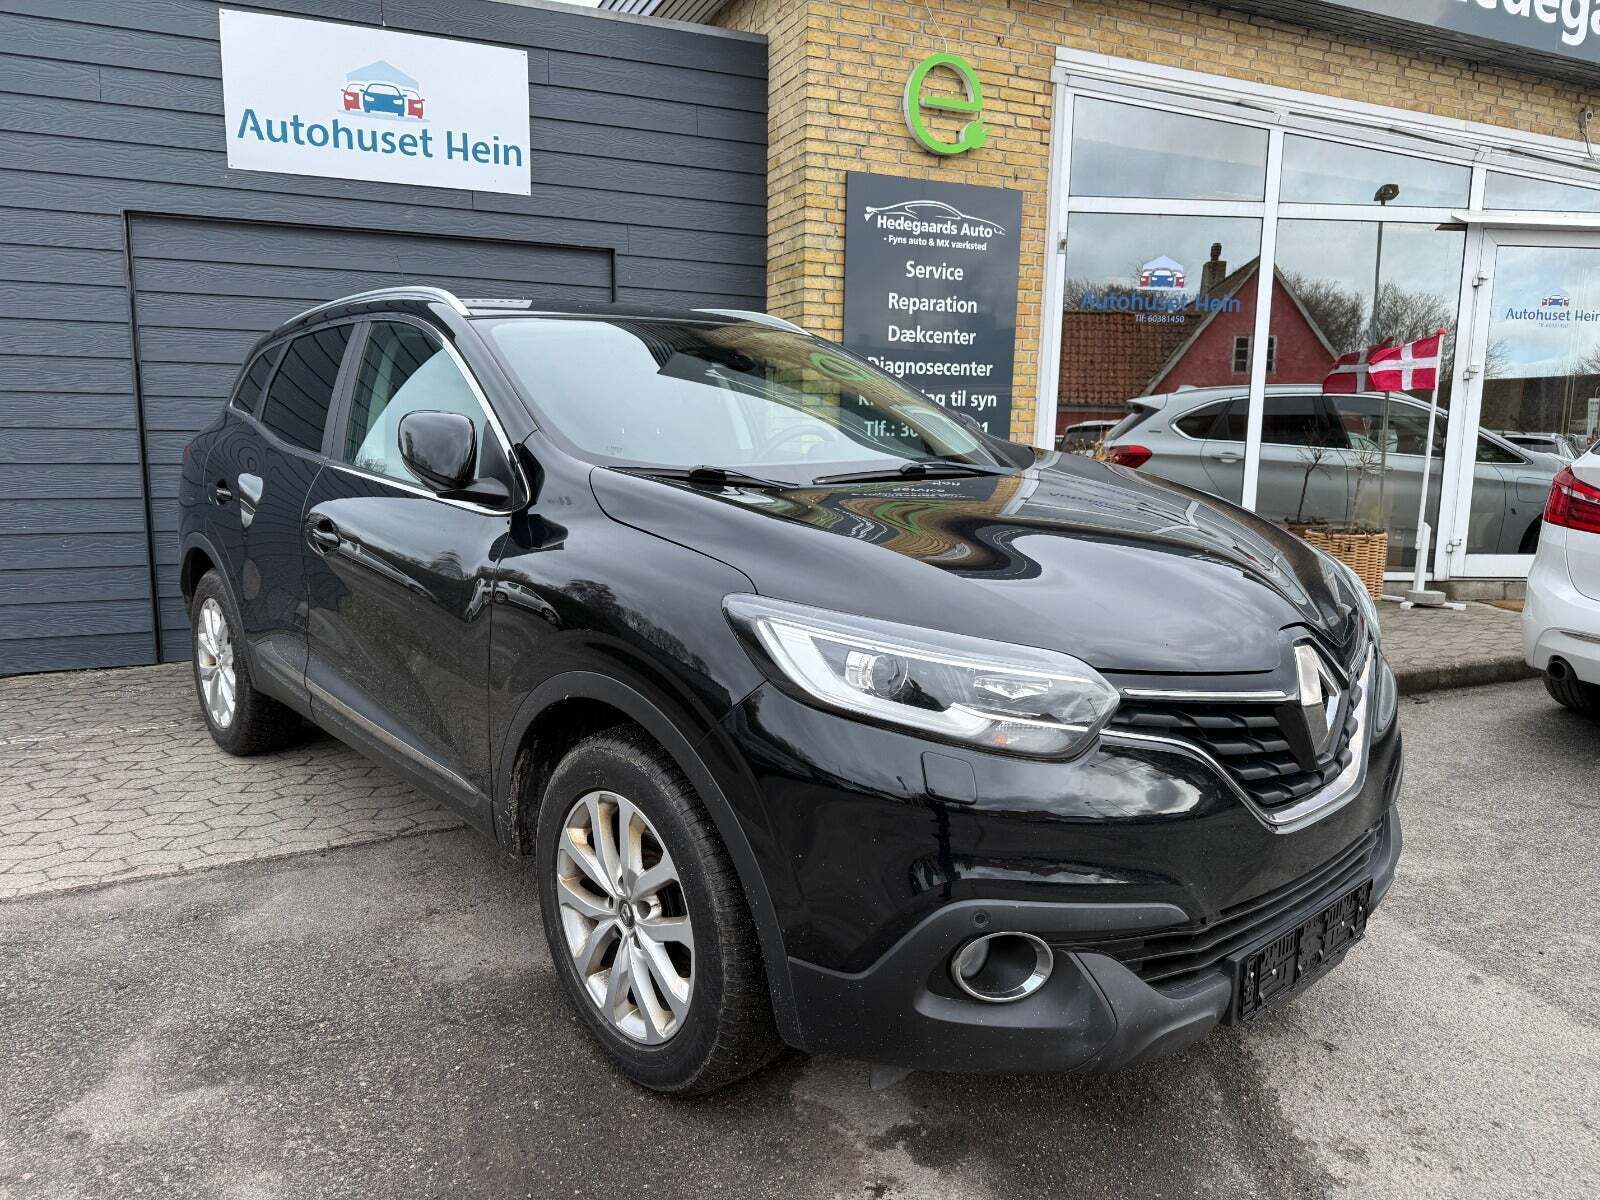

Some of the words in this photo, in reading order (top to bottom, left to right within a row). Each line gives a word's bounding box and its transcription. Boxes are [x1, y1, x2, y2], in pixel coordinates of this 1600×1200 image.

[237, 108, 433, 158] Autohuset
[446, 131, 522, 167] Hein
[877, 214, 958, 235] Hedegaards
[960, 223, 993, 238] Auto
[888, 234, 907, 246] Fyns
[908, 237, 927, 246] auto
[928, 238, 935, 247] &
[936, 239, 950, 248] MX
[951, 240, 987, 251] værksted
[905, 260, 964, 281] Service
[888, 292, 978, 314] Reparation
[1080, 289, 1188, 312] Autohuset
[1195, 293, 1241, 313] Hein
[1506, 308, 1571, 321] Autohuset
[888, 325, 977, 345] Dækcenter
[950, 389, 966, 407] til
[970, 393, 997, 411] syn
